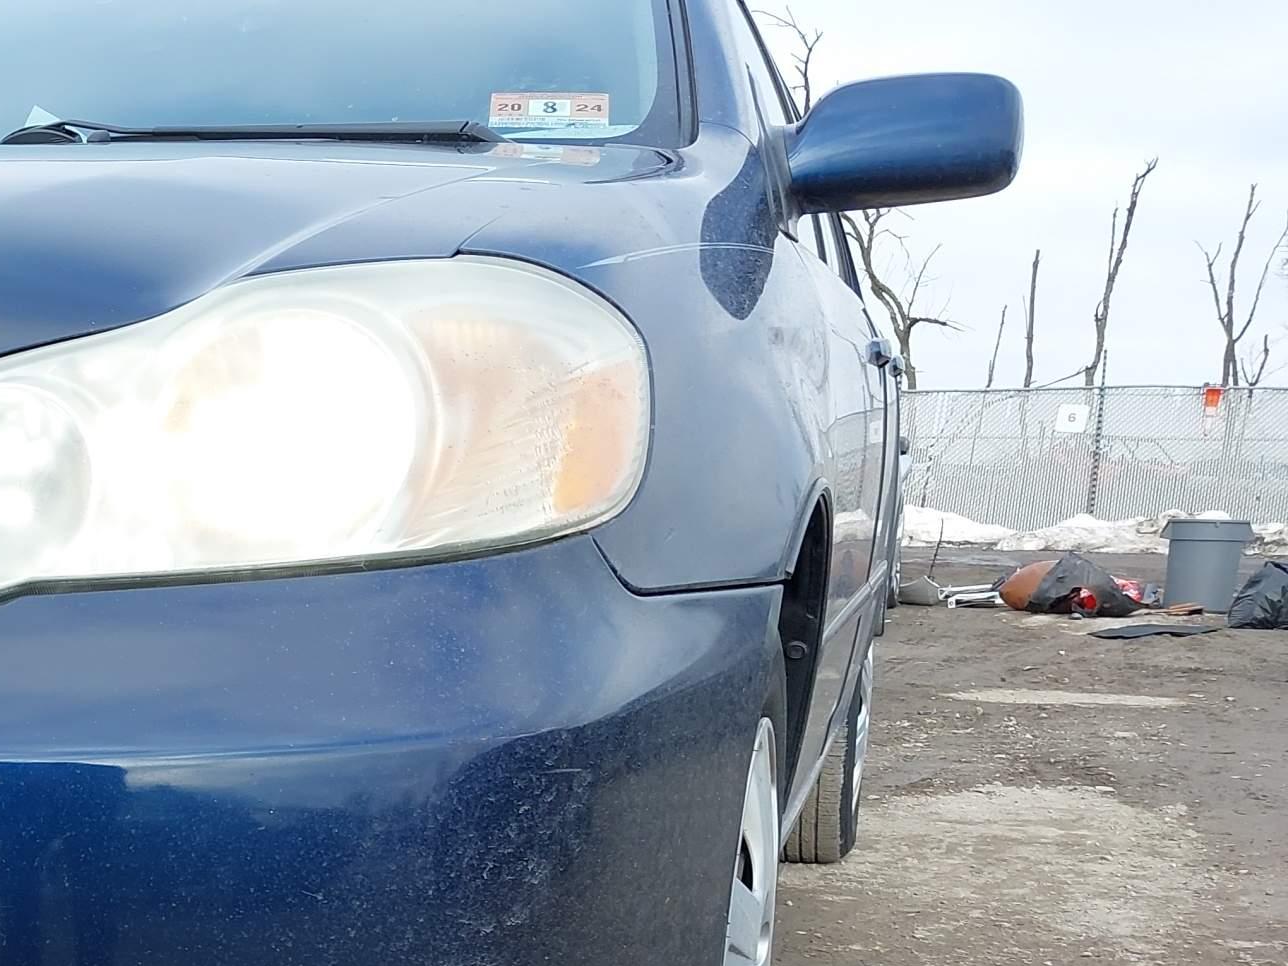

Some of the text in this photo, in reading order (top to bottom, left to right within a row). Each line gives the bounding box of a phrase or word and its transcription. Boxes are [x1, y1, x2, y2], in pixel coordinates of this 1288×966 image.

[497, 101, 602, 114] 20 8 24
[1068, 412, 1077, 423] 6
